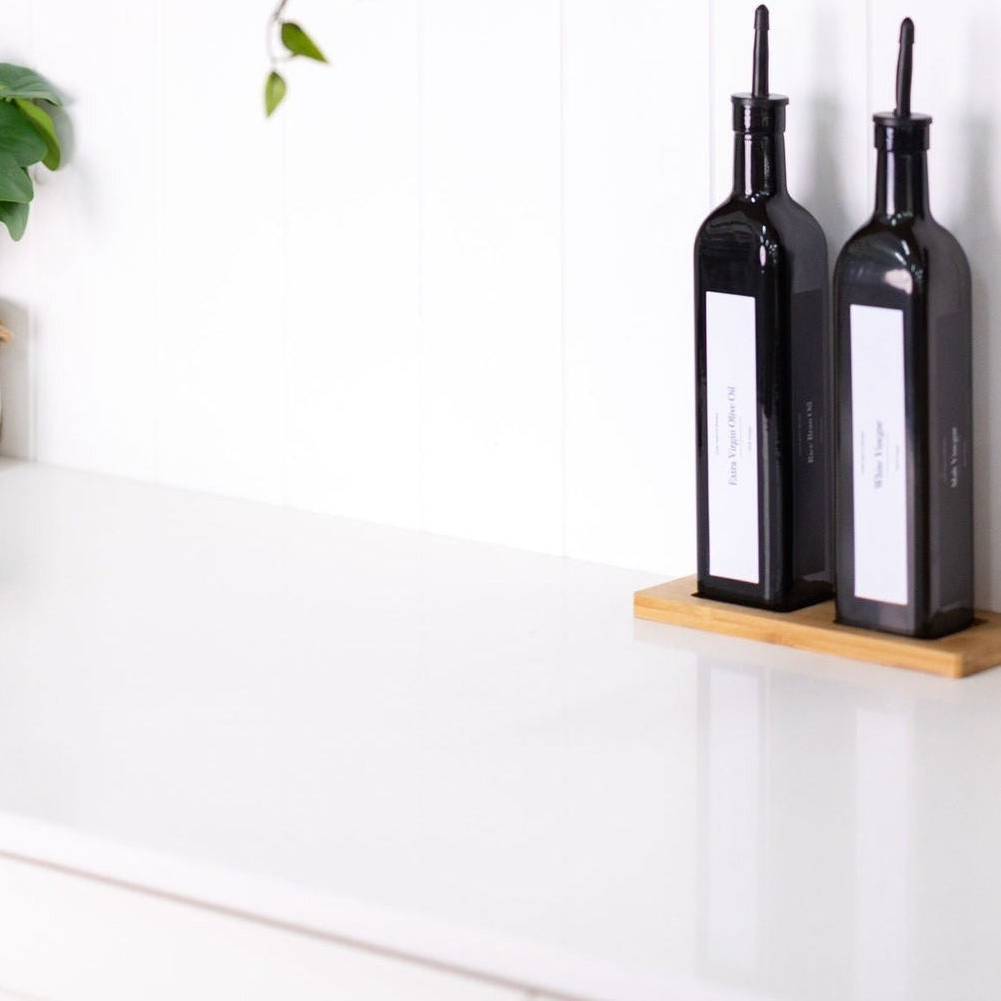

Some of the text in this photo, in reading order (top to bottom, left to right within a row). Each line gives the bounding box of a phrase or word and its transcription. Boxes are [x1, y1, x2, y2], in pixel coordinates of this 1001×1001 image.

[727, 385, 739, 486] Extra Virgin Olive Oil
